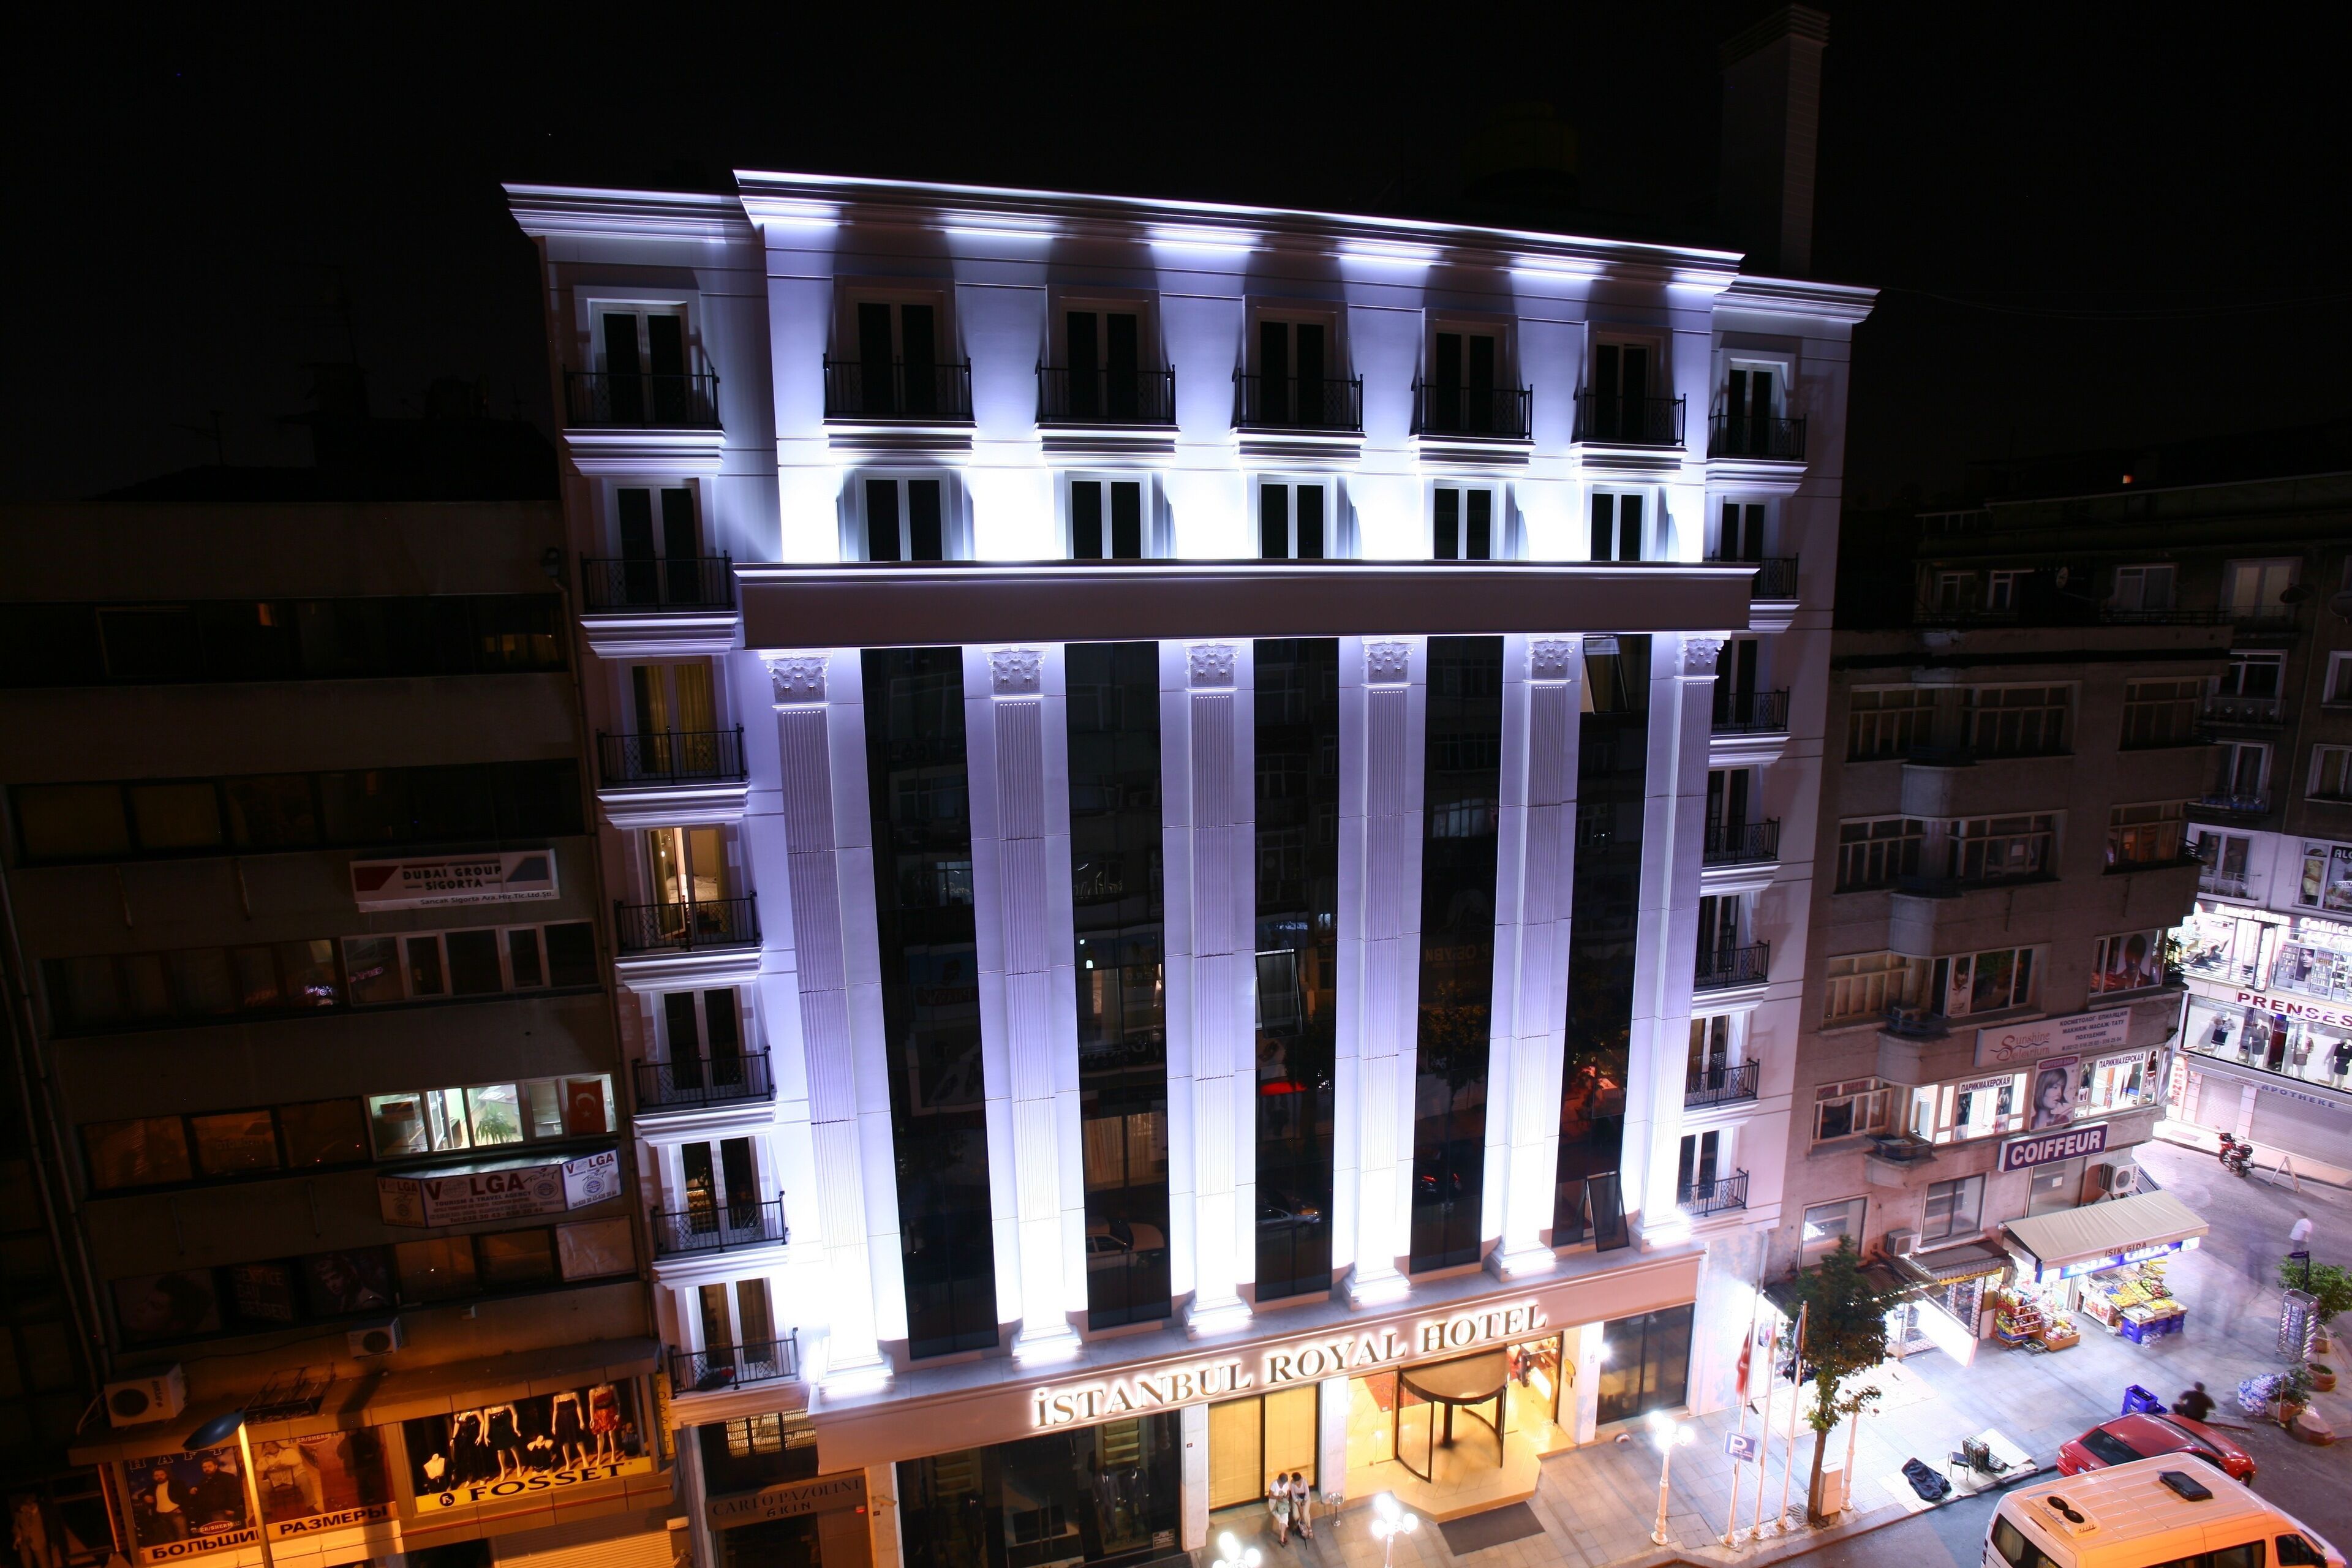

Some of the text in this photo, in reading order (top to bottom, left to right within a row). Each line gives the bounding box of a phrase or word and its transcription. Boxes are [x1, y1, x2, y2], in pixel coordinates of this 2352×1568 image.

[403, 865, 502, 880] DUBAI GROUP
[2098, 1054, 2144, 1068] ПАРИКМАХЕРСКАЯ
[1961, 1077, 2011, 1092] ПАРИКМАХЕРСКАЯ
[2261, 1085, 2335, 1108] APOTHEKE
[2011, 1130, 2101, 1166] COIFFEUR
[435, 1198, 467, 1207] TOURISM
[505, 1191, 531, 1199] AGENCY
[2126, 1242, 2147, 1252] GIDA
[1034, 1303, 1547, 1427] İSTANBUL ROYAL HOTEL
[657, 1379, 671, 1449] FOSSET
[1729, 1434, 1747, 1454] P
[469, 1462, 625, 1502] FOSSET
[712, 1479, 859, 1516] CARLO PAZOLINI
[152, 1506, 388, 1559] БОЛЬШИ РАЗМЕРЫ
